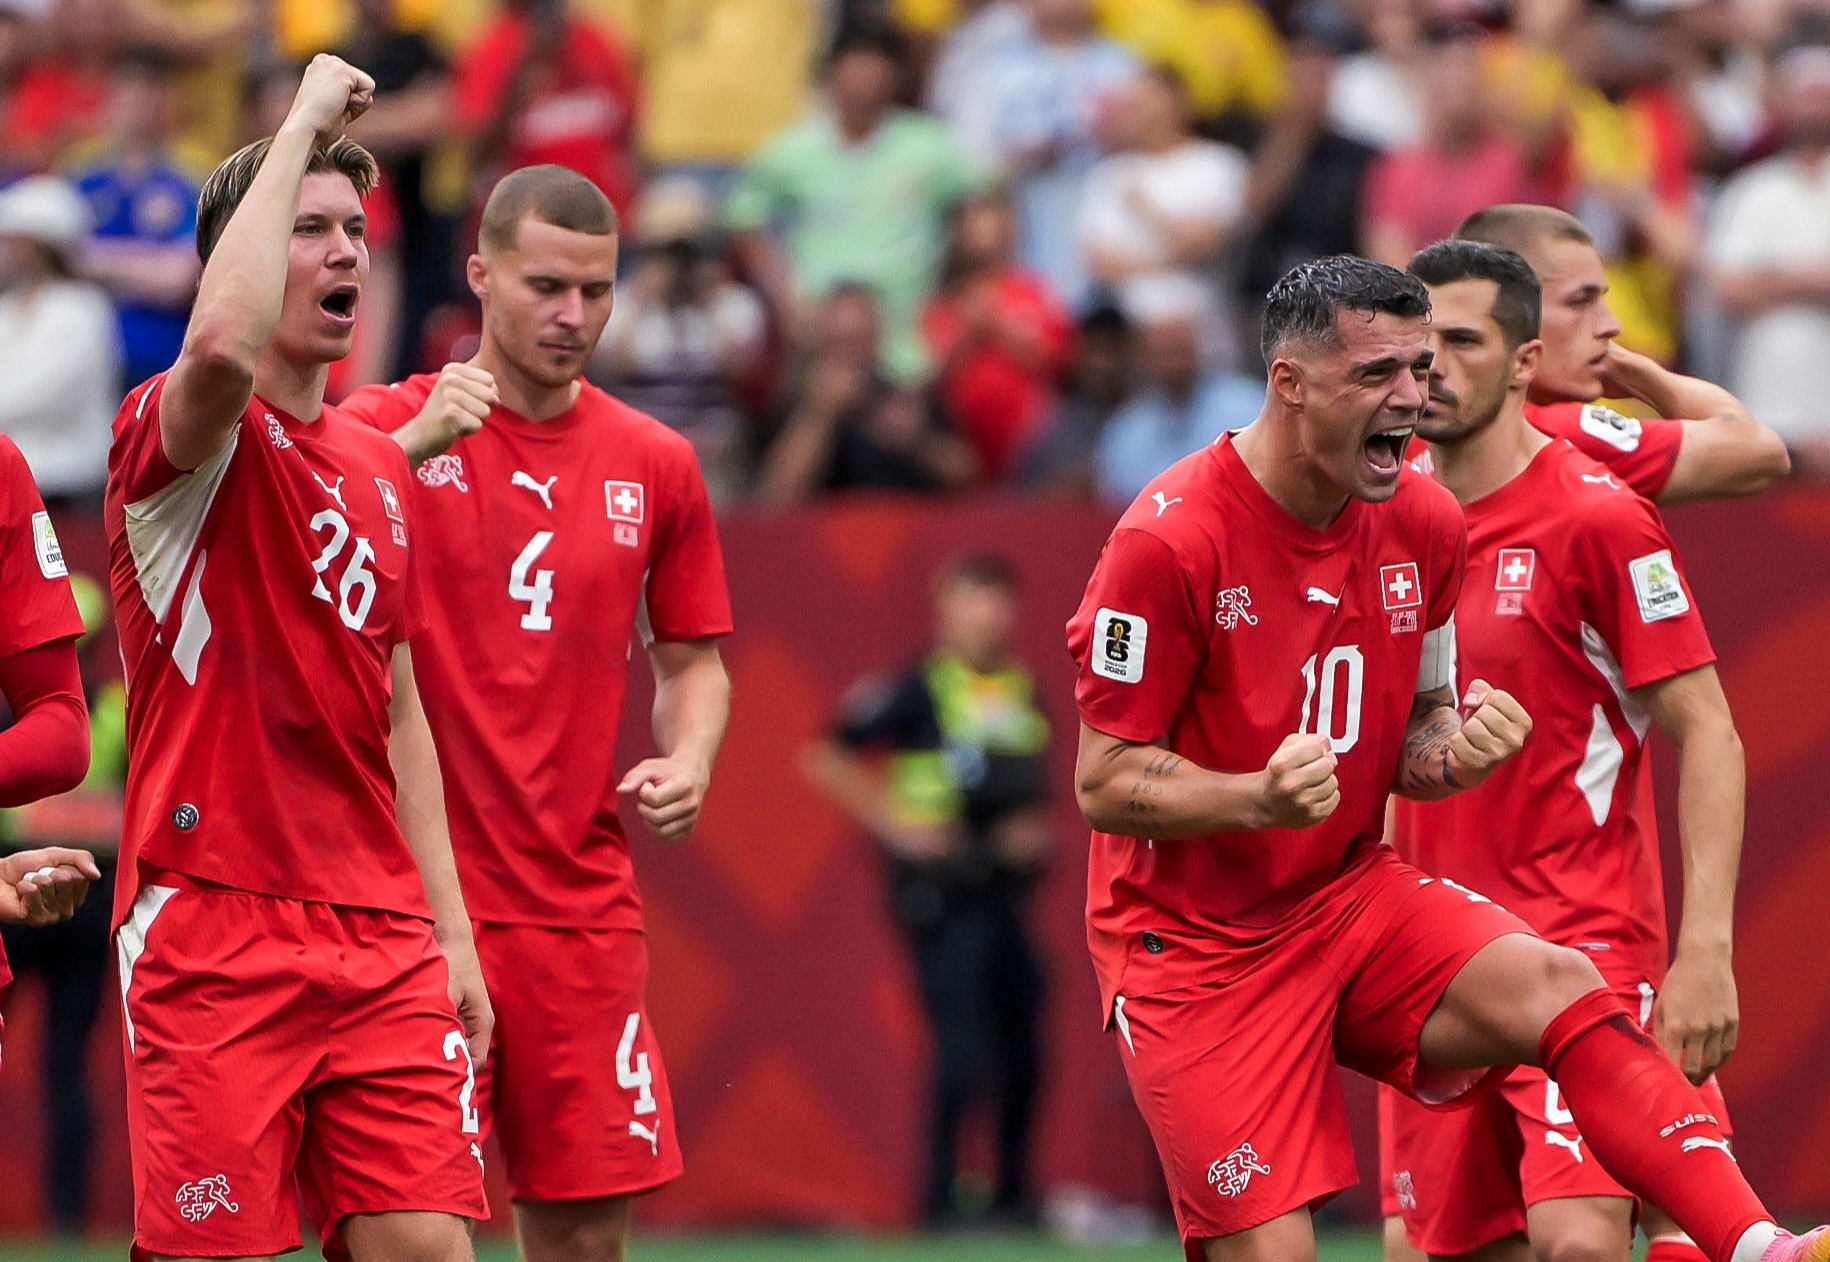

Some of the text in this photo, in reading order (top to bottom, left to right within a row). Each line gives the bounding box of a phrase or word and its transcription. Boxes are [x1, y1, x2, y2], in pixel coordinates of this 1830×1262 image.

[309, 508, 376, 632] 26
[508, 531, 555, 631] 4
[1104, 665, 1127, 676] 2026
[1298, 644, 1364, 753] 10
[442, 1030, 479, 1134] 2
[615, 1012, 657, 1115] 4
